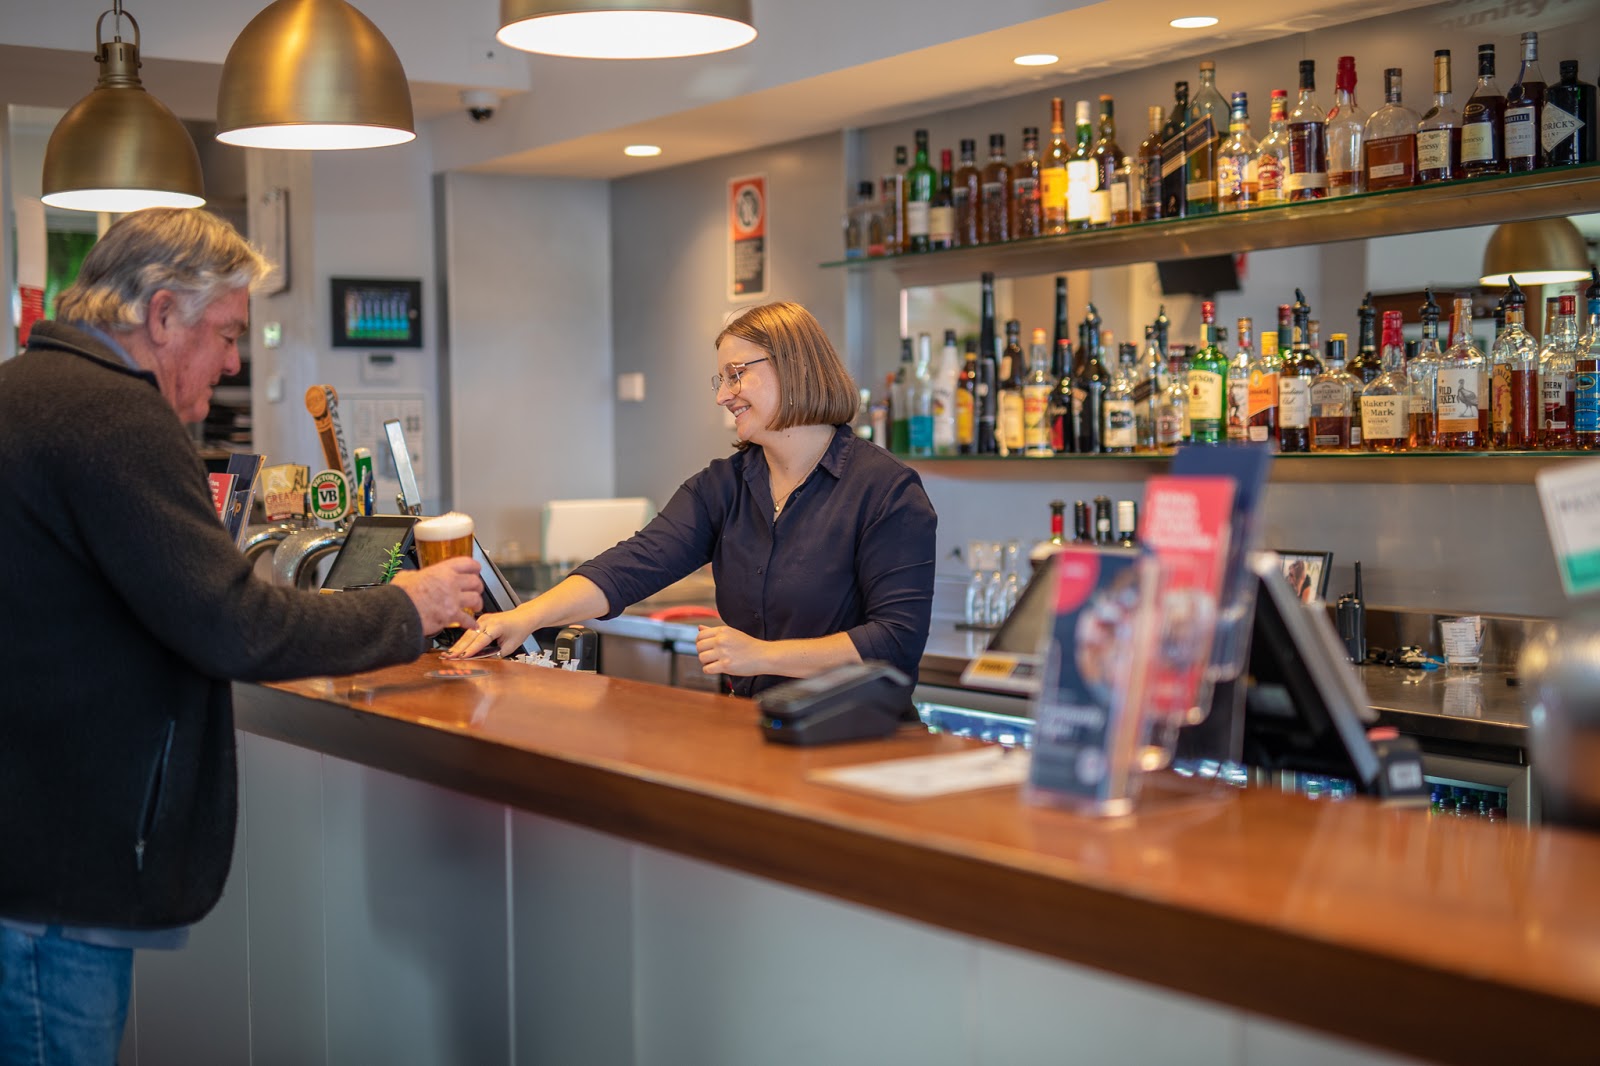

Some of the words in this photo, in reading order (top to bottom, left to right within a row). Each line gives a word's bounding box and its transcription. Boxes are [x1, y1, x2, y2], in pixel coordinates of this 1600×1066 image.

[1542, 120, 1576, 131] DRICK'S
[1543, 381, 1563, 390] THERN
[1363, 400, 1396, 408] Maker's
[1370, 408, 1396, 417] Mark
[312, 474, 342, 487] VICTORIA
[319, 490, 338, 503] VB
[316, 507, 343, 519] BITTER
